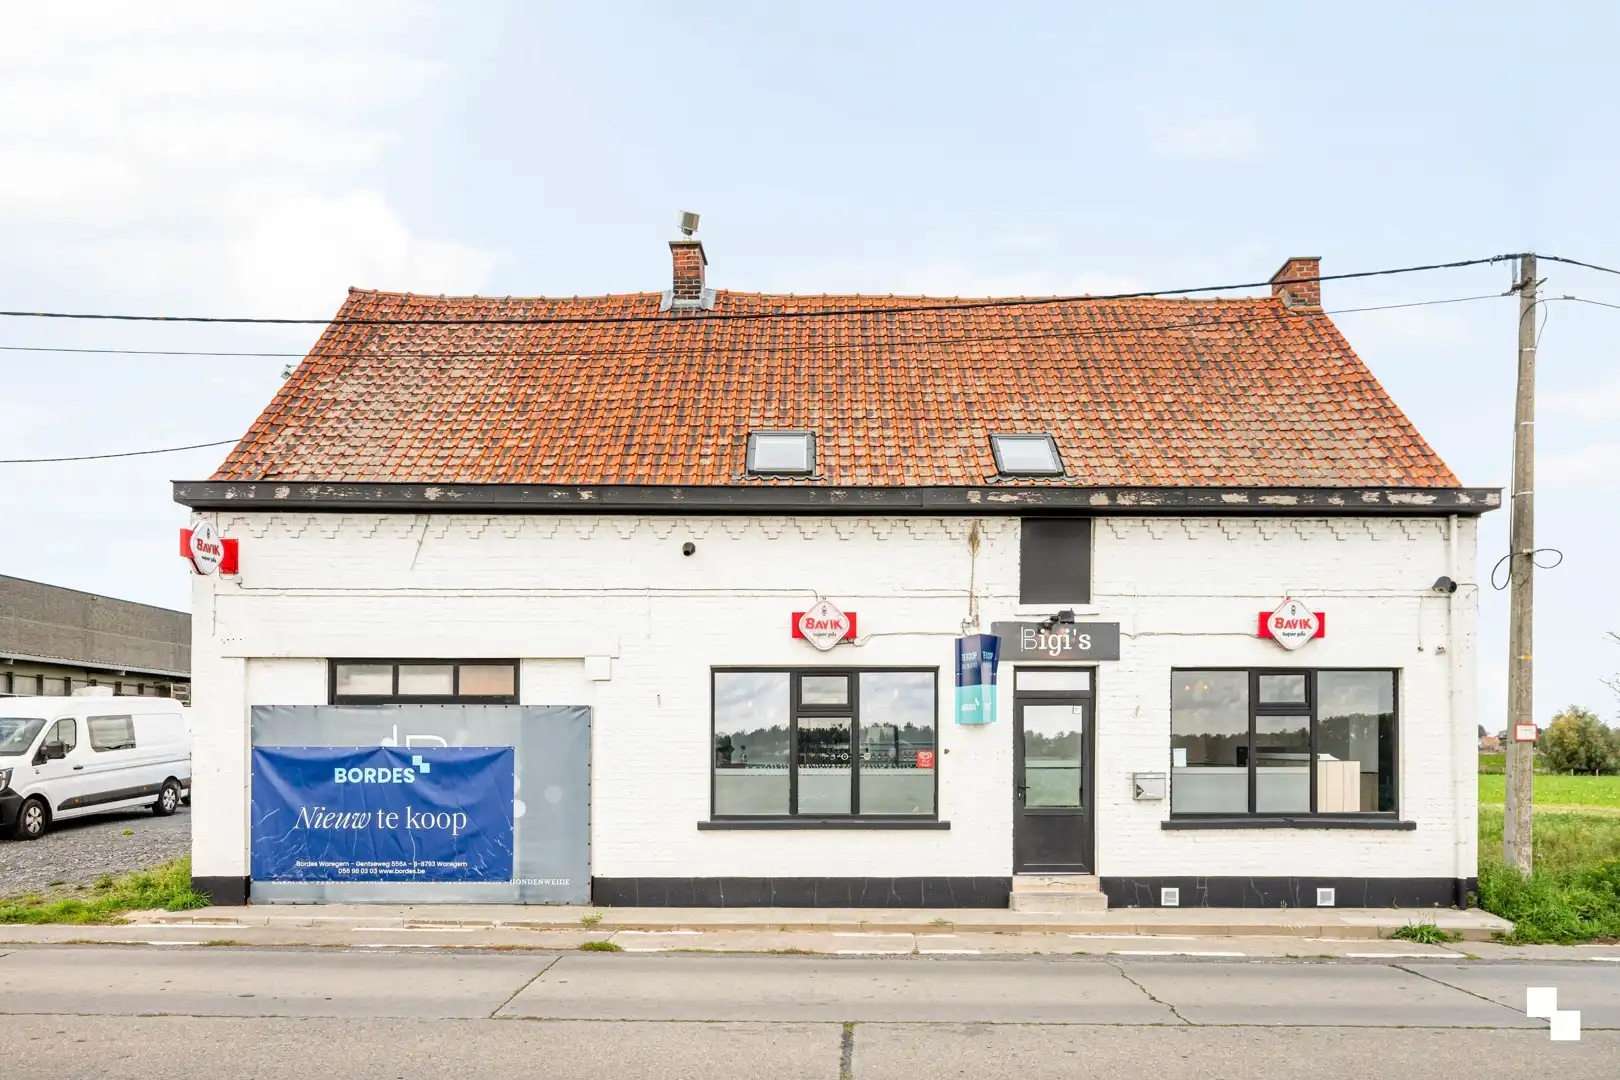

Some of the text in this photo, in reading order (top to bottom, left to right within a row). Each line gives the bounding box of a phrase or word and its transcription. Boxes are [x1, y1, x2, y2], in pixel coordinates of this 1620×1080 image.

[196, 538, 221, 556] BAVIK
[805, 617, 843, 629] BAVIK
[1274, 617, 1313, 629] BAVIK
[1021, 627, 1092, 656] Bigi's
[334, 767, 416, 783] BORDES
[294, 806, 467, 836] Nieuw te koop
